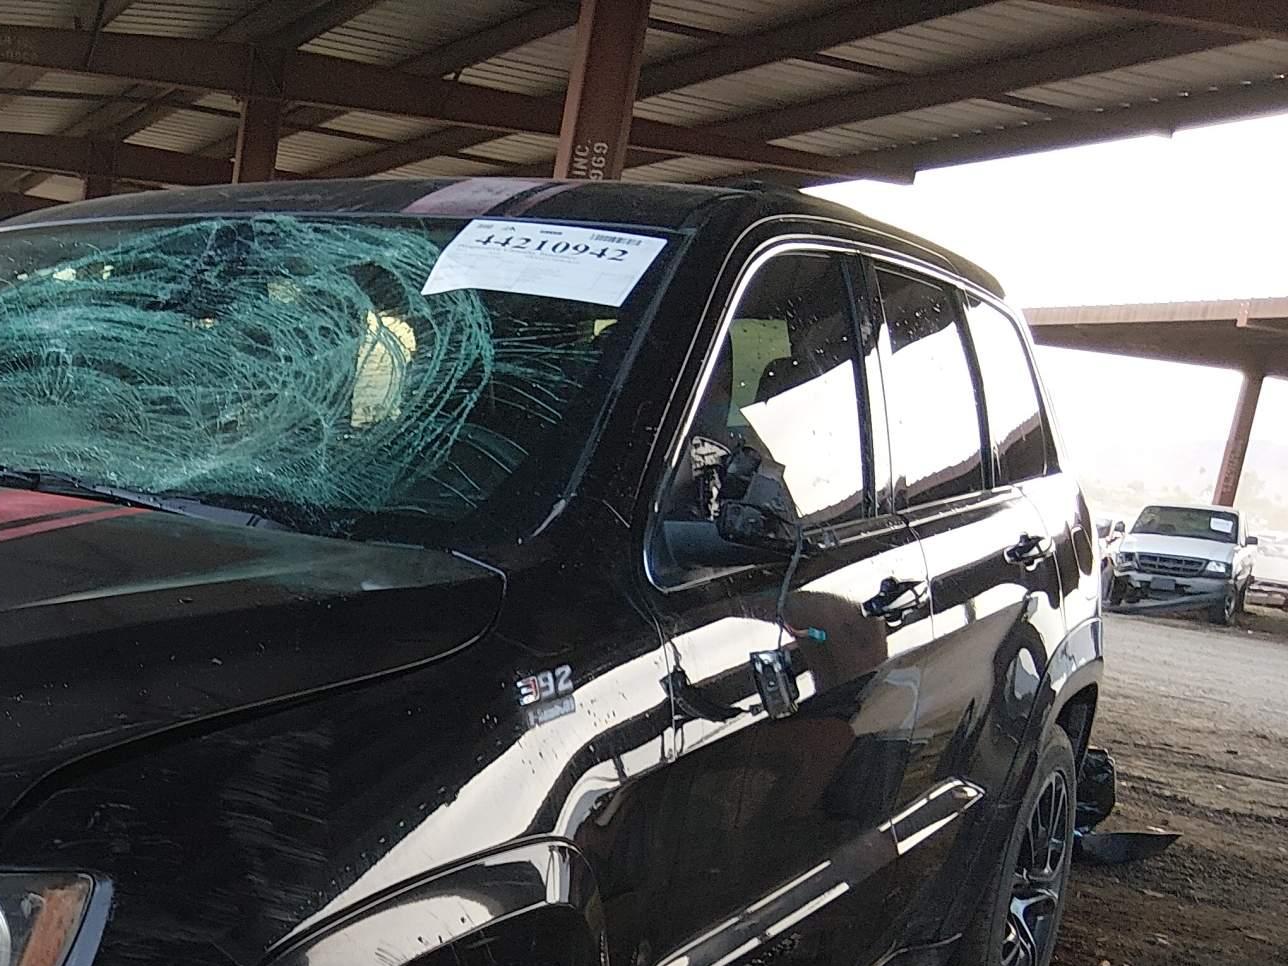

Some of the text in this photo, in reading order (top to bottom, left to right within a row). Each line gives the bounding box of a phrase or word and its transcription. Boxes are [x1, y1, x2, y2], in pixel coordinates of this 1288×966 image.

[572, 140, 592, 176] INC.
[475, 234, 629, 262] 44210942
[516, 664, 574, 706] 392
